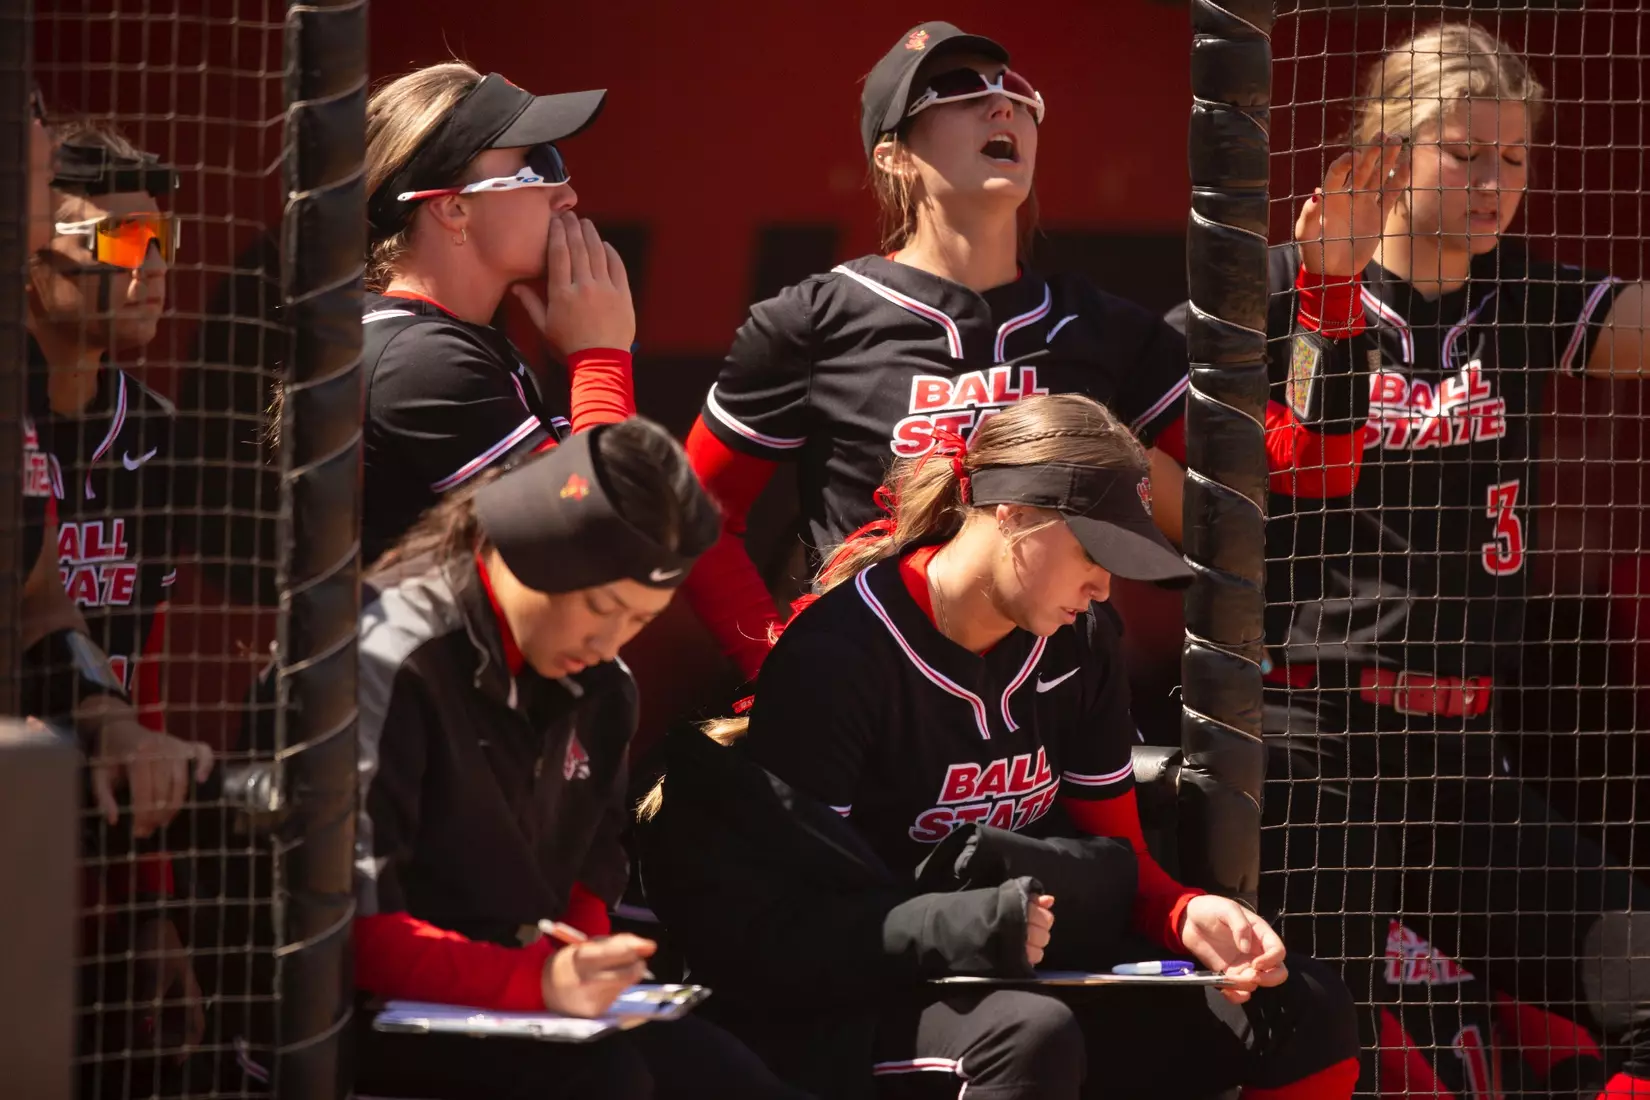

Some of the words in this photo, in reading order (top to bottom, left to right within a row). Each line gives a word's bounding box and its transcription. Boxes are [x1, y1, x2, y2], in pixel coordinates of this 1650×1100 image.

[909, 366, 1050, 414] BALL
[1368, 359, 1491, 412] BALL
[58, 518, 128, 565] ALL
[1482, 479, 1523, 576] 3
[937, 745, 1052, 806] BALL
